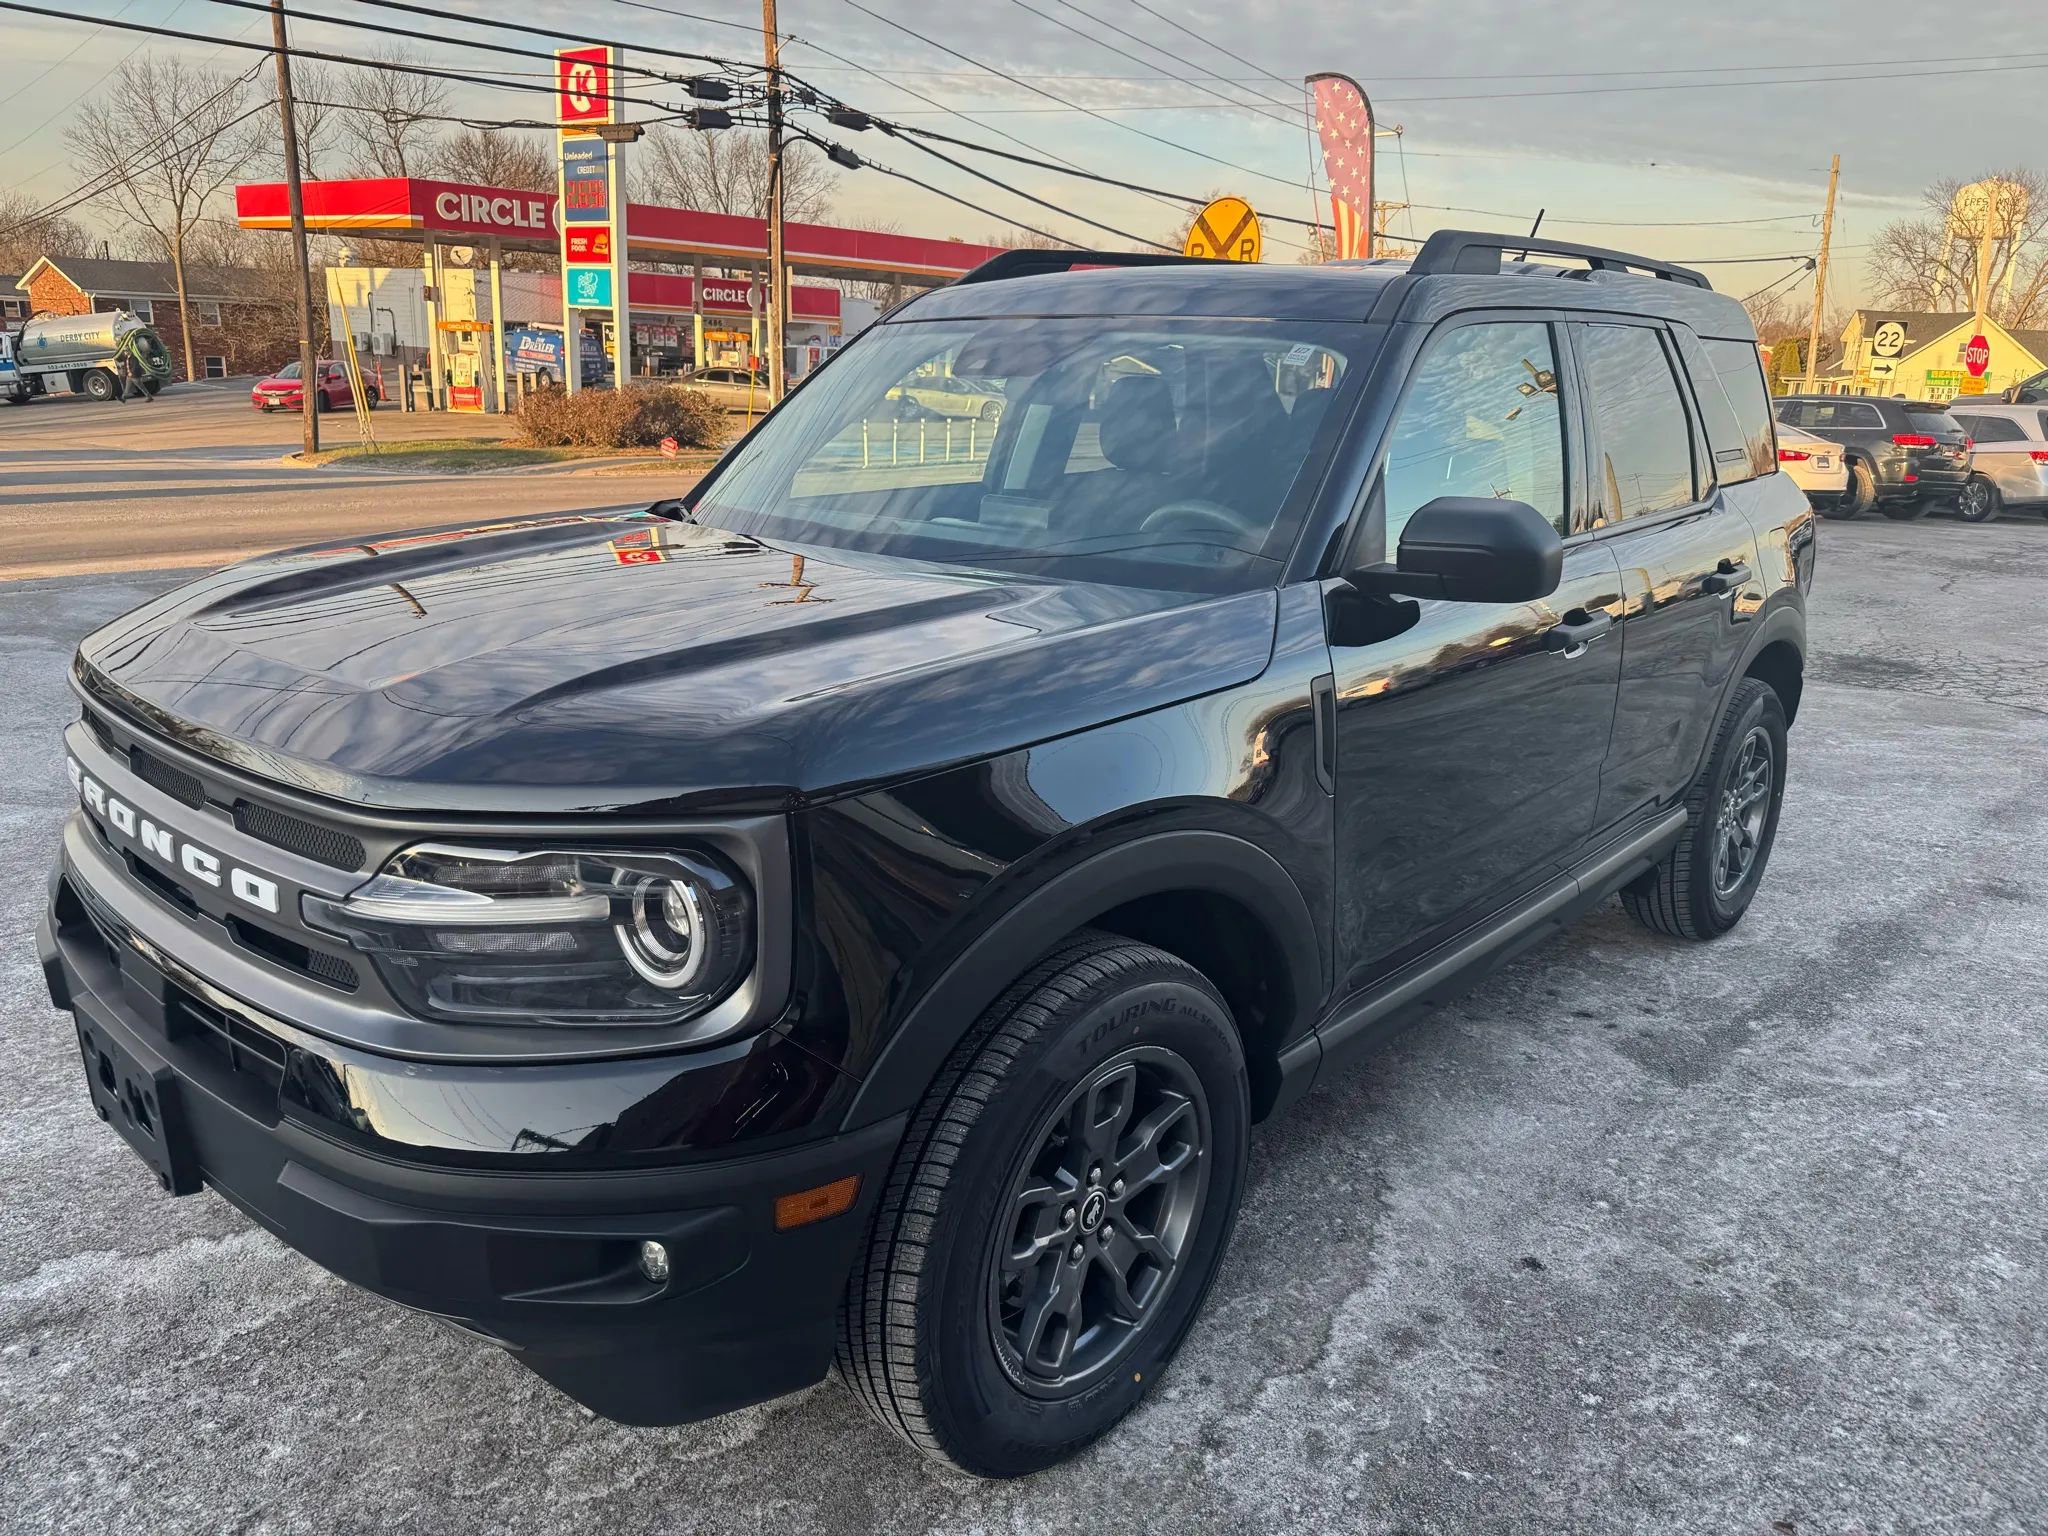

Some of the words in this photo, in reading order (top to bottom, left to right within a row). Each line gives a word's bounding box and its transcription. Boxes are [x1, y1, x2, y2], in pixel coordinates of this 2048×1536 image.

[564, 151, 593, 160] Unleaded
[577, 165, 595, 174] CREDIT
[436, 191, 546, 229] CIRCLE
[570, 237, 588, 245] FRESH
[1239, 238, 1255, 263] R
[702, 287, 745, 303] CIRCLE
[60, 333, 82, 342] DERBY
[84, 332, 100, 340] CITY
[519, 336, 555, 354] DREXLER
[1877, 331, 1900, 348] 22
[1967, 347, 1989, 365] STOP
[66, 755, 280, 915] BRONCO
[1076, 998, 1177, 1055] TOURING
